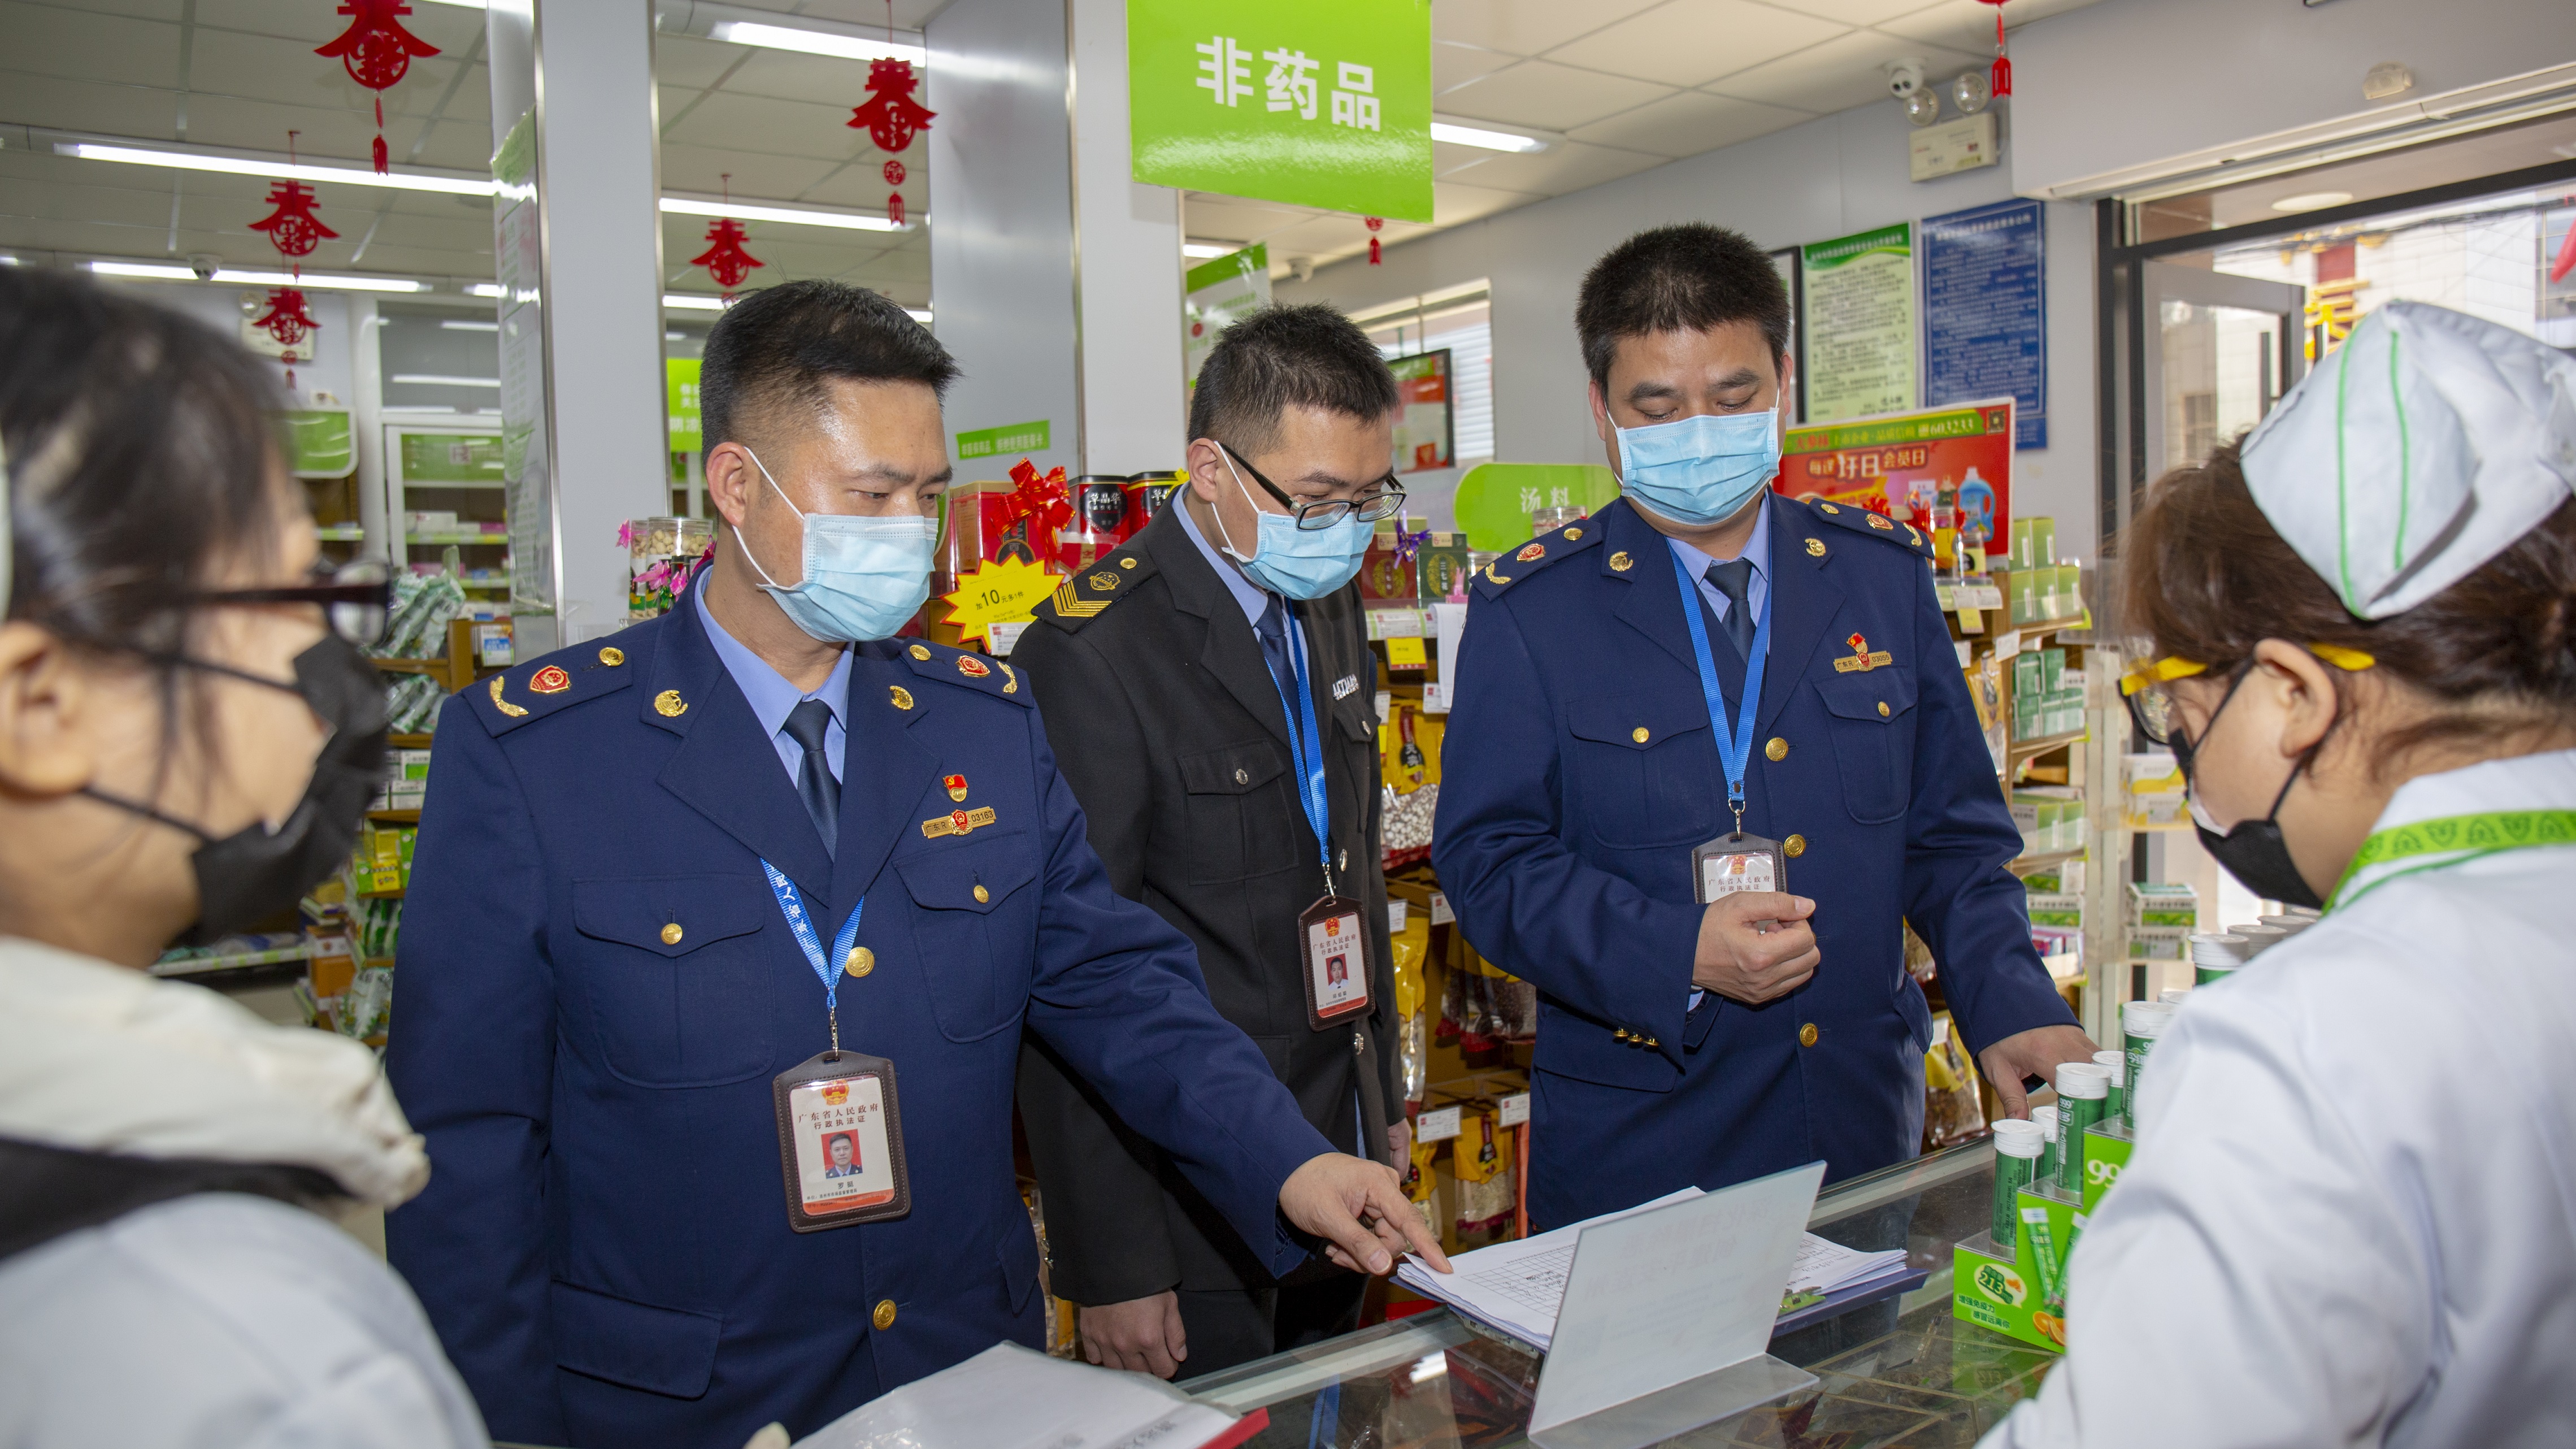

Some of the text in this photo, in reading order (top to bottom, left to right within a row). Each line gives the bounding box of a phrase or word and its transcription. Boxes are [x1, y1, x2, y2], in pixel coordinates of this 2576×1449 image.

[1195, 36, 1381, 132] 非药品
[1930, 417, 1974, 435] 603233
[1520, 487, 1569, 514] 汤料
[976, 589, 1024, 610] 加10元多1件
[1872, 654, 1890, 663] 03055
[971, 810, 993, 822] 03163
[1708, 875, 1770, 886] 广东省人民政府
[1720, 884, 1760, 892] 行政执法证
[1313, 933, 1357, 951] 广东省人民政府
[1321, 943, 1350, 956] 行政执法证
[798, 1103, 879, 1123] 广东省人民政府
[813, 1116, 866, 1130] 行政执法证
[1958, 1294, 1996, 1313] 增强免疫力
[1973, 1310, 2010, 1329] 感冒远离你
